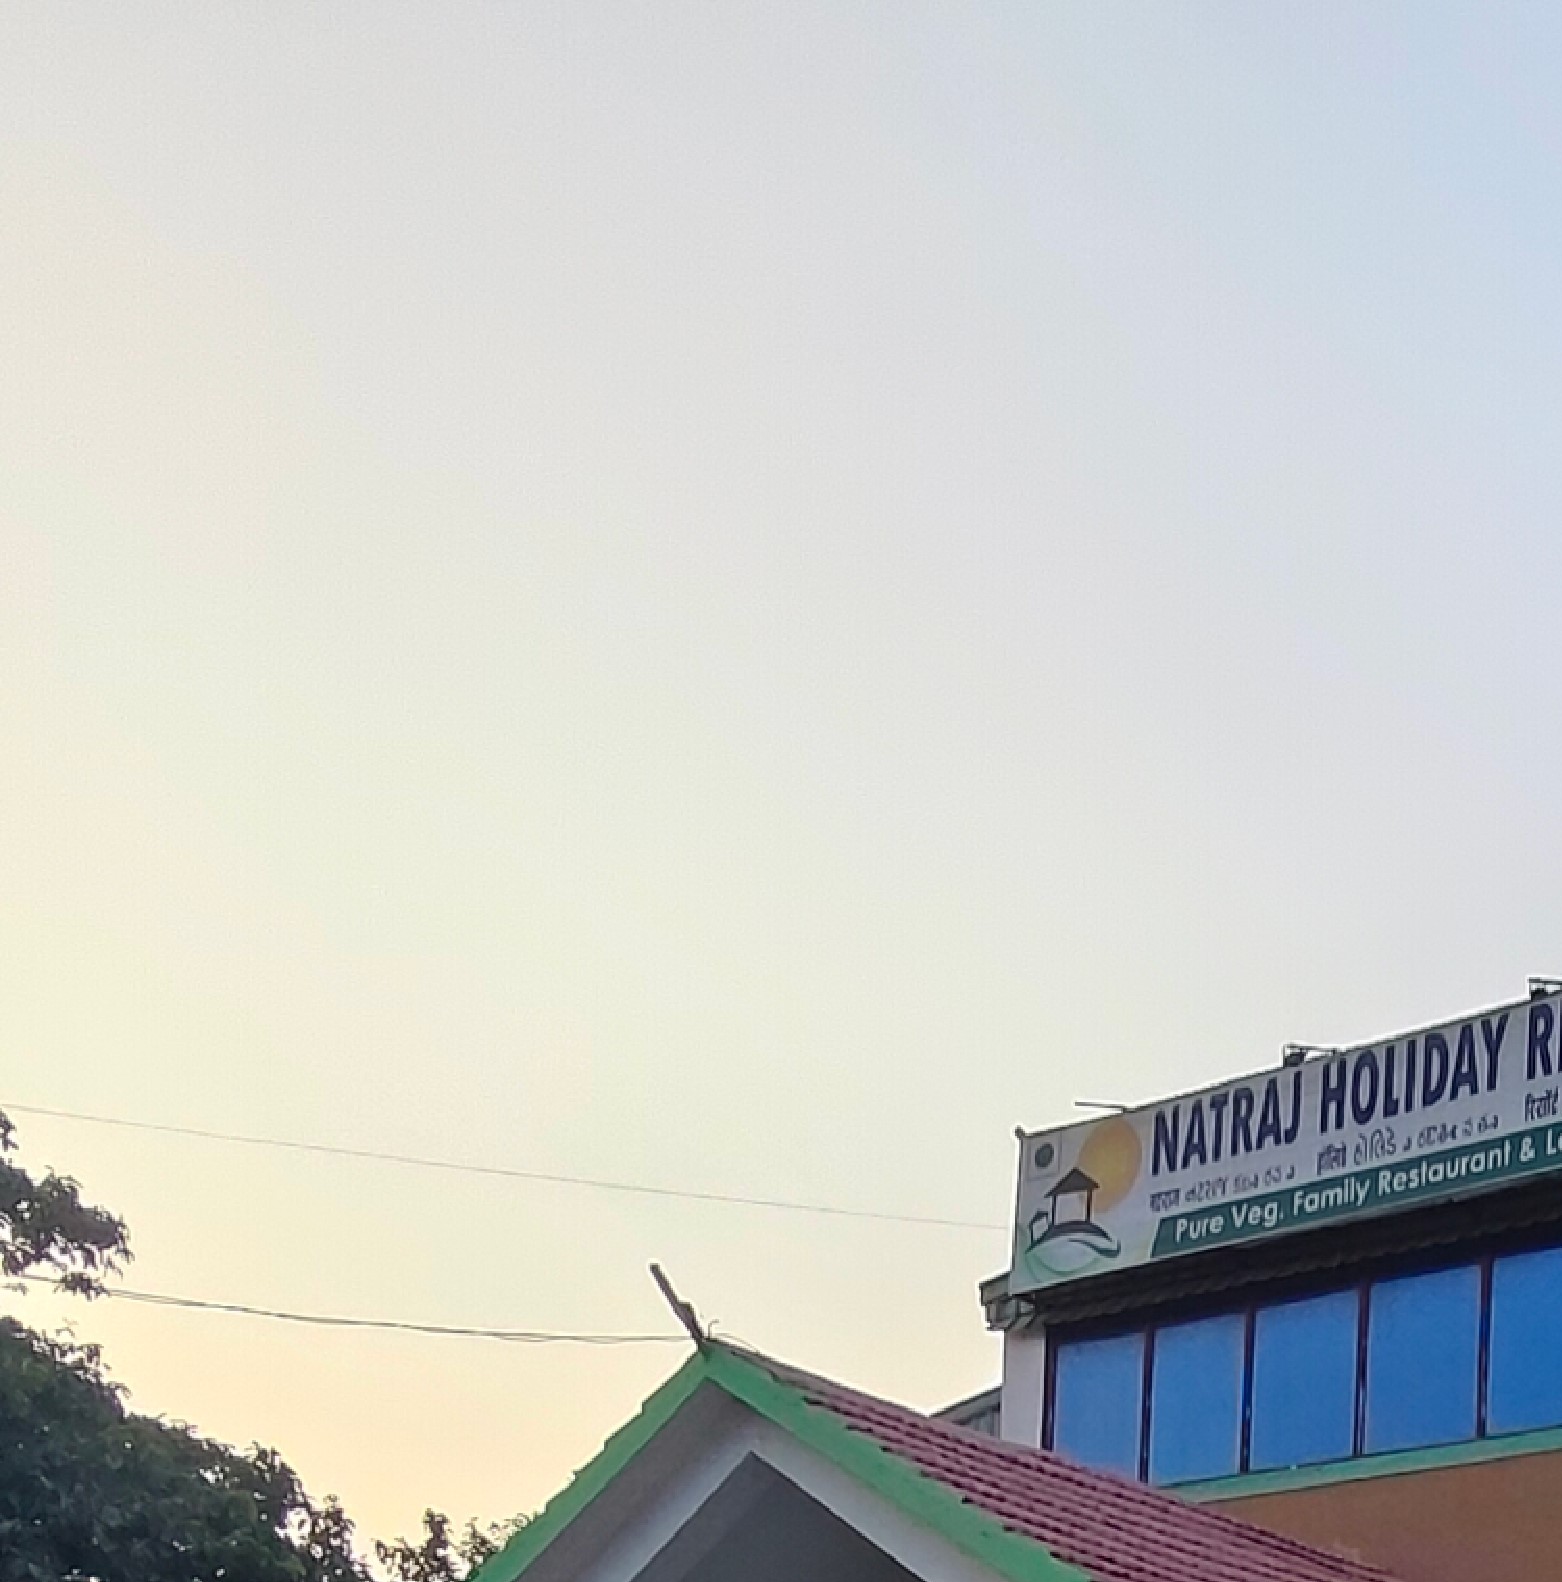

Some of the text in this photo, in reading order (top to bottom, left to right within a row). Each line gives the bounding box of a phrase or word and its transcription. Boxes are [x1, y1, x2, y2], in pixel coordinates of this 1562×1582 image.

[1151, 1069, 1302, 1177] NATRAJ
[1319, 1012, 1510, 1134] HOLIDAY
[1174, 1214, 1224, 1244] Pure
[1293, 1176, 1370, 1217] Family
[1378, 1139, 1511, 1197] Restaurant
[1518, 1135, 1537, 1163] &
